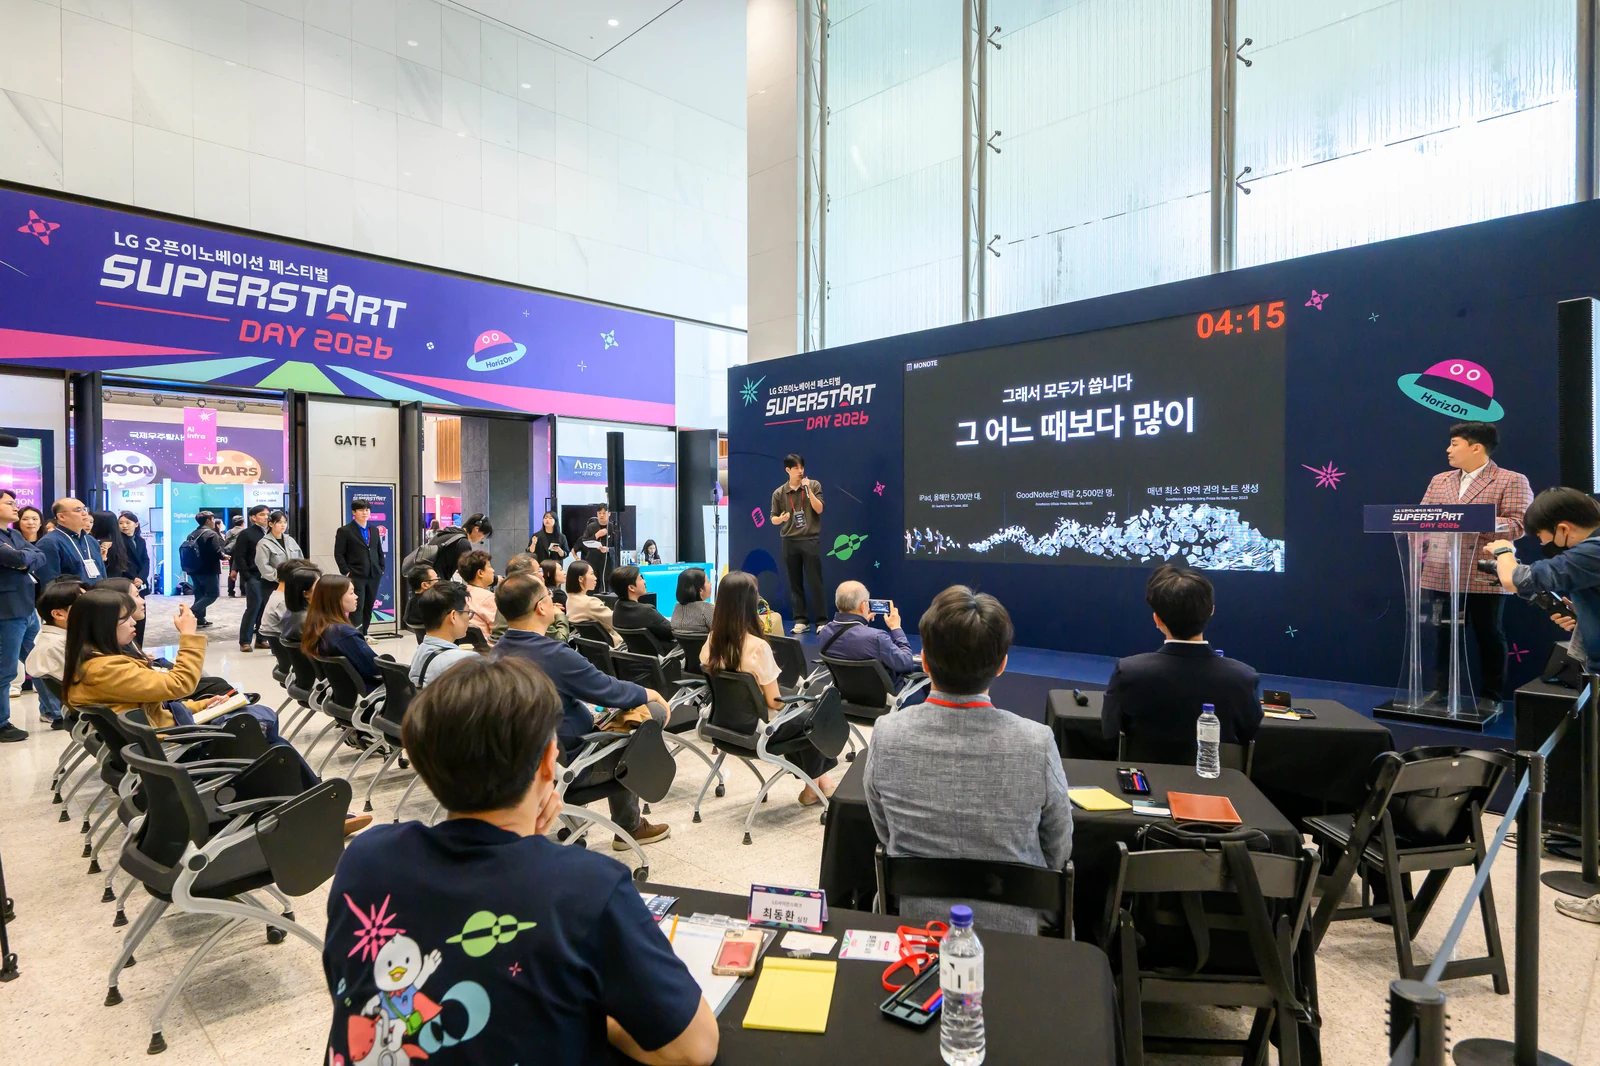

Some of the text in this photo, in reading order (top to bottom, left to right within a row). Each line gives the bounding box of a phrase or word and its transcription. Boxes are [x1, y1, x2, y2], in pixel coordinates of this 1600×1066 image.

[114, 231, 329, 283] LG 오픈이노베이션 페스티벌
[100, 253, 407, 329] SUPERSTART
[1197, 301, 1285, 339] 04:15
[239, 319, 393, 360] DAY 2026
[486, 356, 513, 368] HorizOn
[913, 360, 938, 370] MONOTE
[769, 376, 841, 396] LG 오픈이노베이션 페스티벌
[1002, 373, 1133, 403] 그래서 모두가 씁니다
[765, 383, 877, 417] SUPERSTART
[1421, 392, 1468, 416] HorizOn
[806, 410, 869, 431] DAY 2026
[956, 396, 1194, 447] 그 어느 때보다 많이
[334, 435, 376, 447] GATE 1
[202, 465, 258, 477] MARS
[574, 460, 602, 470] Ansys
[951, 492, 973, 502] 5,700만
[1016, 490, 1060, 498] GoodNotes만
[1076, 488, 1104, 498] 2,500만
[1147, 484, 1259, 496] 매년 최소 19억 권의 노트 생성
[1392, 512, 1464, 521] SUPERSTART
[763, 908, 794, 922] 최동환
